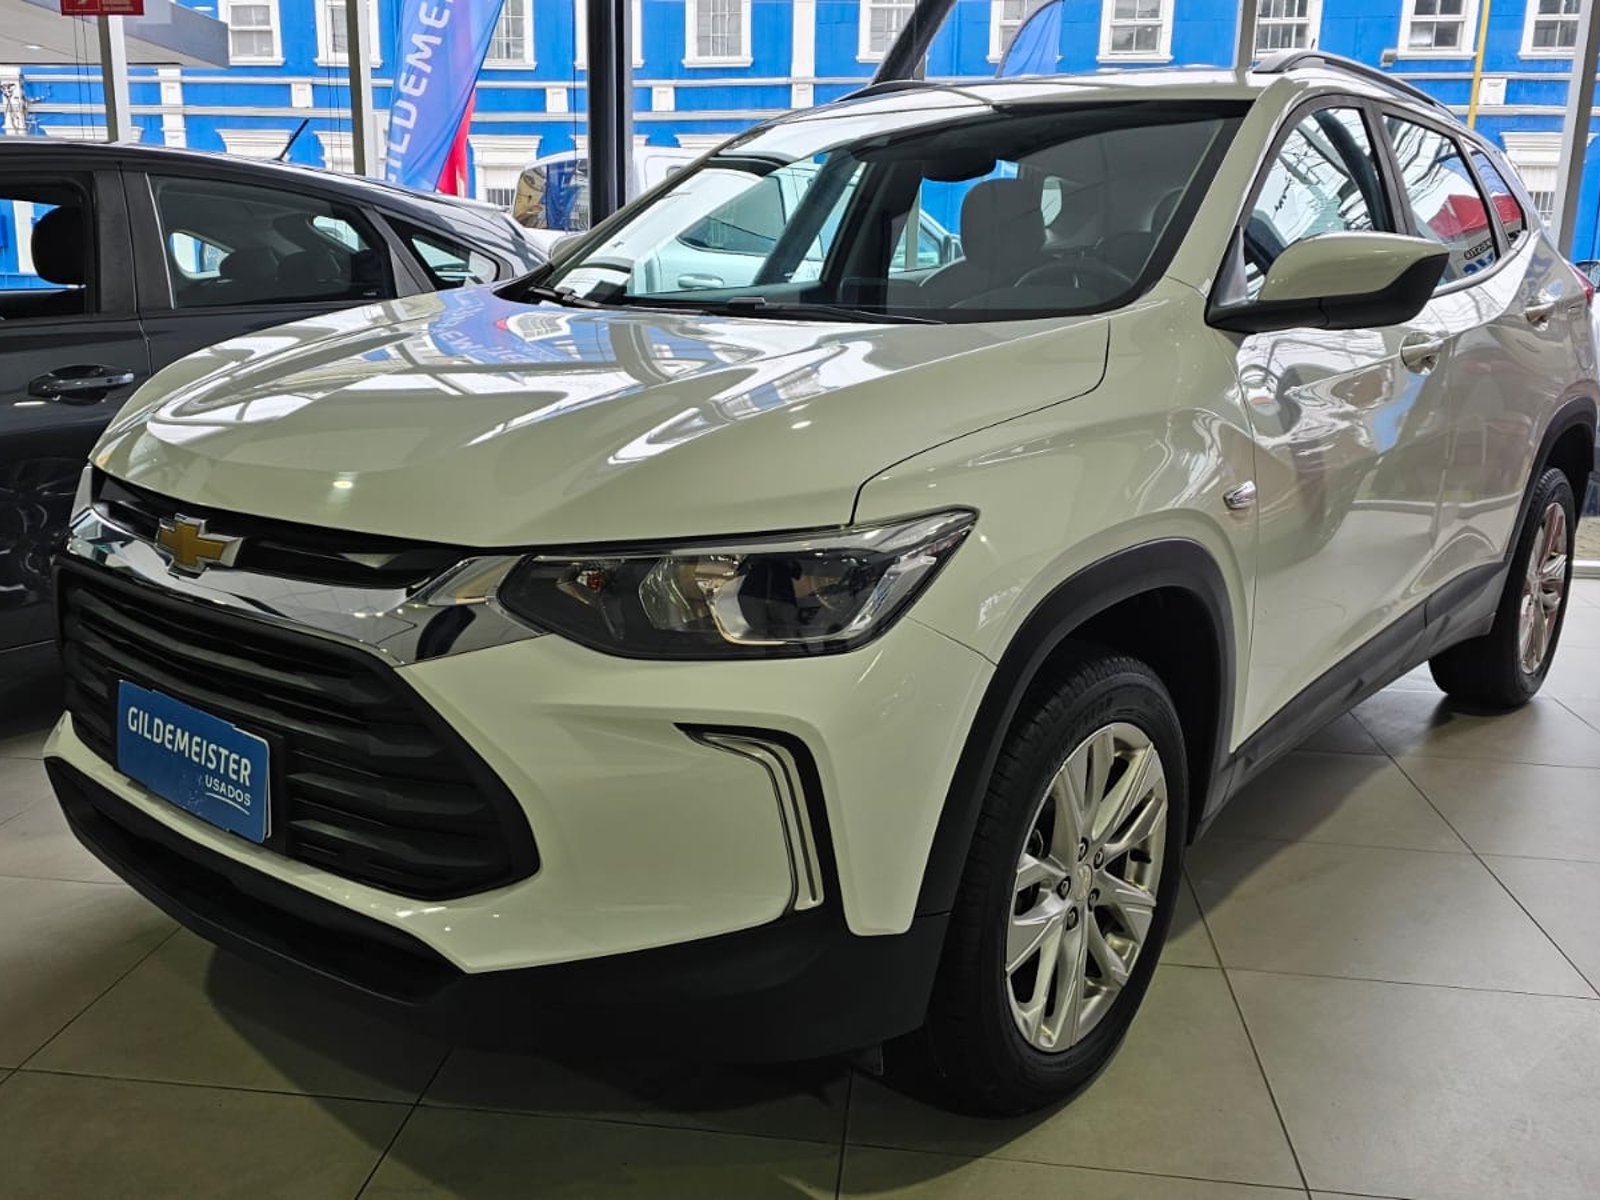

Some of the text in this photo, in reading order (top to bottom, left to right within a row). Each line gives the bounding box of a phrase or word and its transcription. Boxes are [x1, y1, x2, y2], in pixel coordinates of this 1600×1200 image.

[387, 0, 451, 183] ILDEME
[127, 706, 251, 786] GILDEMEISTER
[205, 774, 251, 807] USADOS
